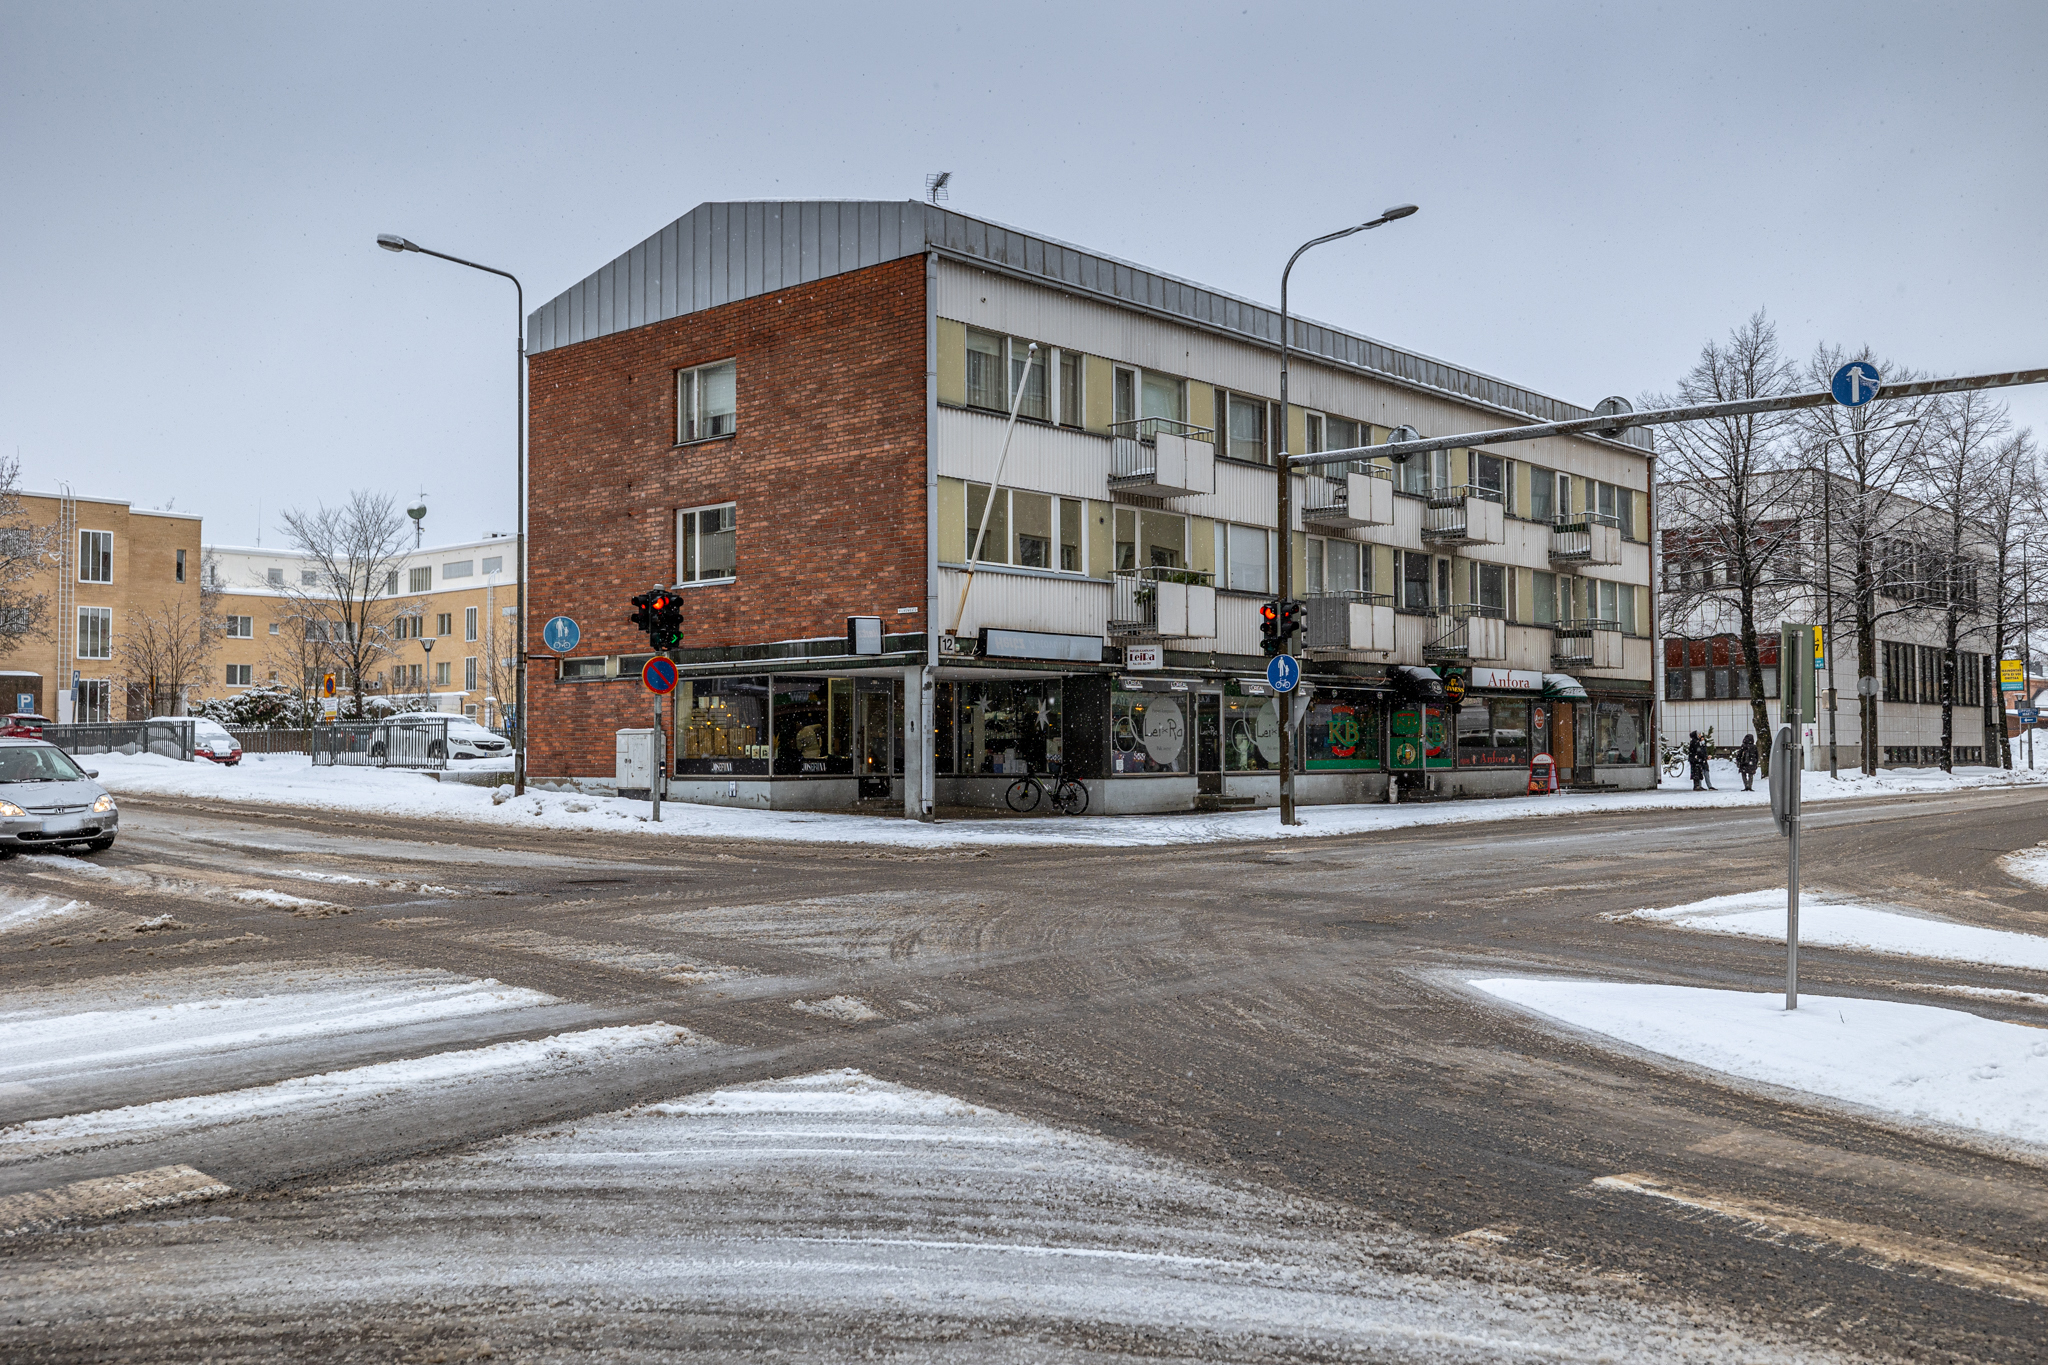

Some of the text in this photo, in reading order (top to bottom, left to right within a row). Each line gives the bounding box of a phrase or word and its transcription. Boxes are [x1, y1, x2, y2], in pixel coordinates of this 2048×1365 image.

[942, 638, 953, 650] 12
[1130, 653, 1155, 661] LeiRa
[73, 671, 79, 687] P
[1488, 669, 1530, 688] Anfora
[21, 695, 31, 708] P
[1327, 721, 1360, 747] KB
[1480, 750, 1508, 763] Anfora
